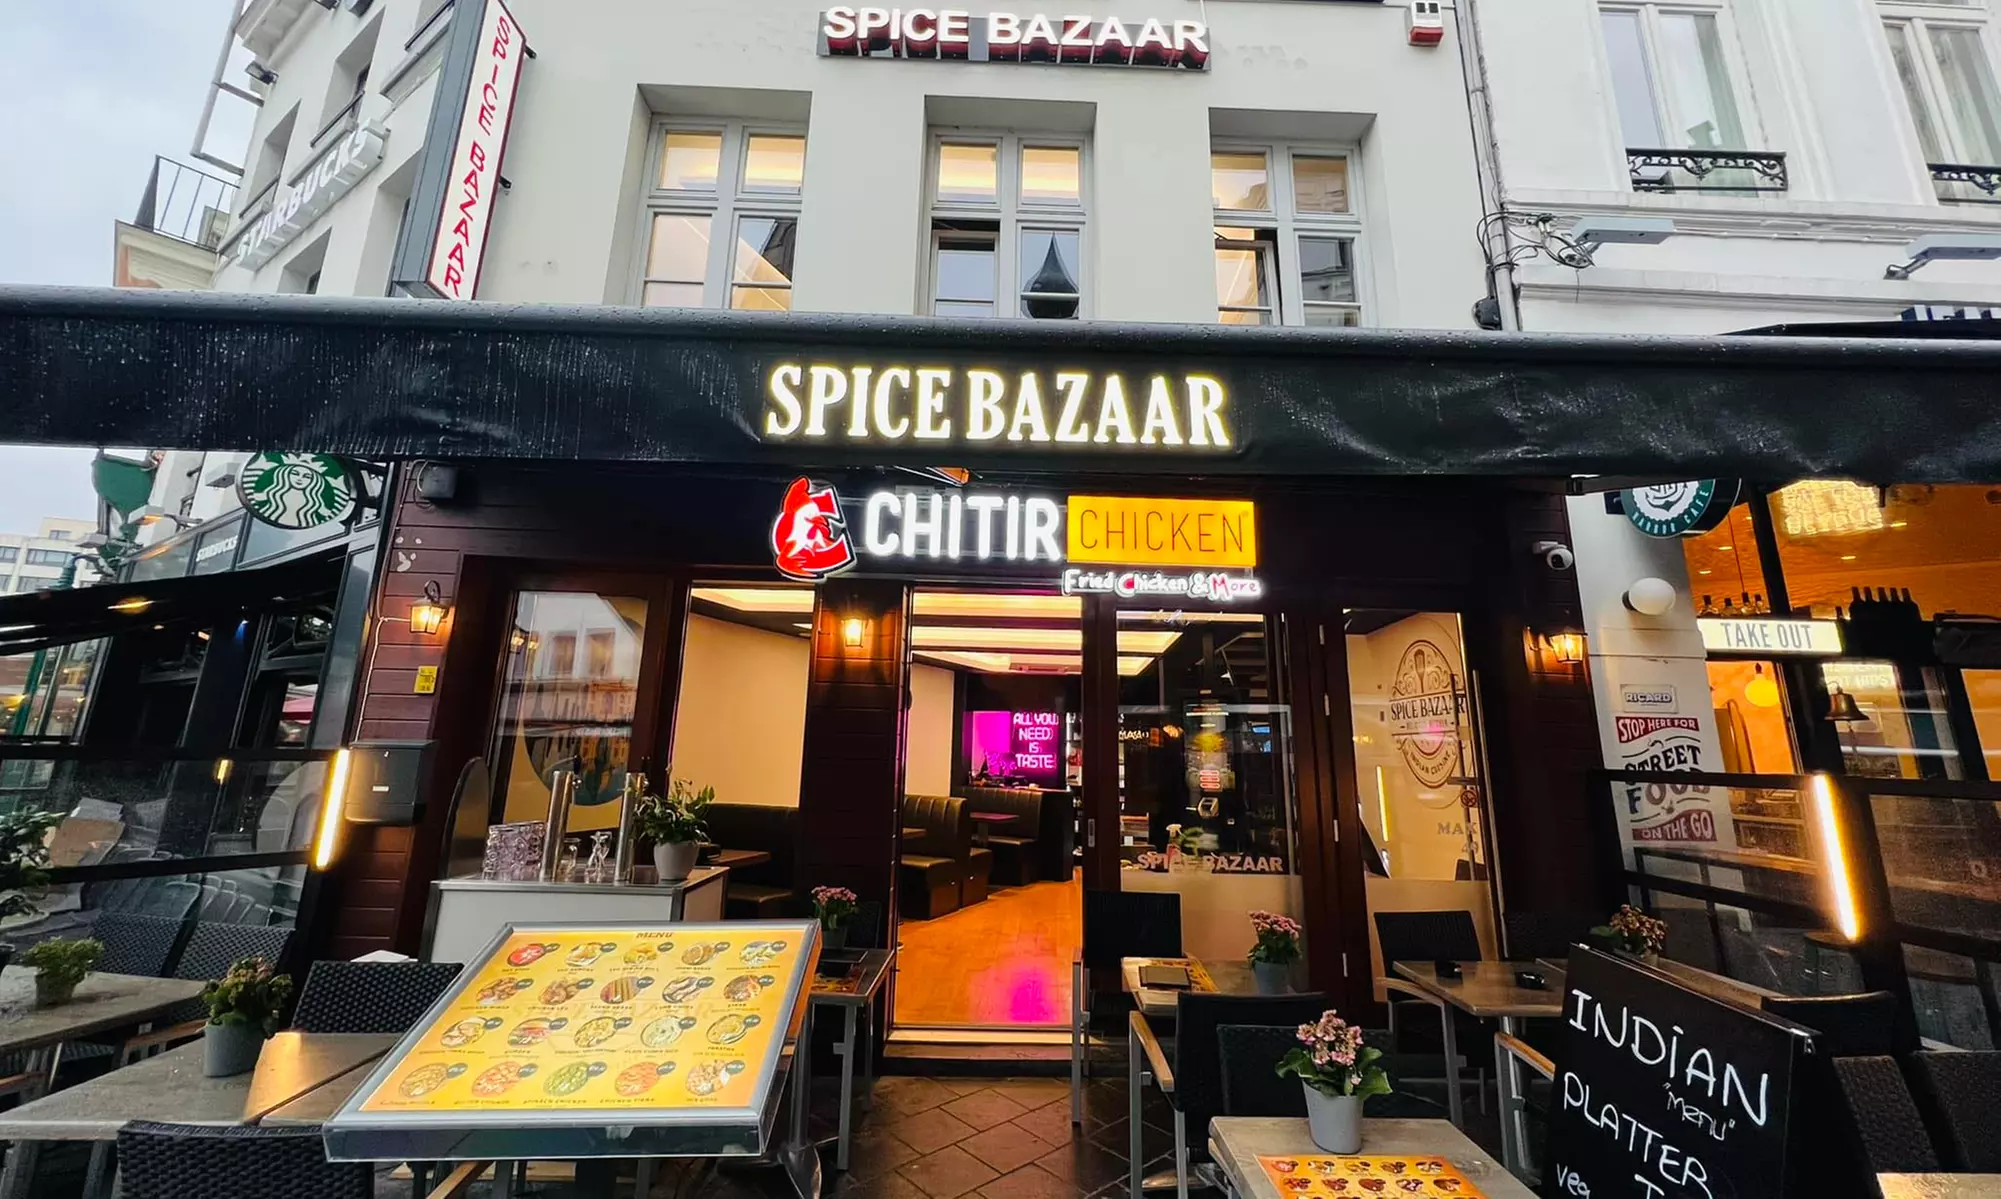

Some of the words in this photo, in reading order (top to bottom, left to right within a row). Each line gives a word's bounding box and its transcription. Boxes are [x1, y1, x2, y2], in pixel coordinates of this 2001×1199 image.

[823, 6, 970, 43] SPICE
[988, 12, 1210, 53] BAZAAR
[478, 16, 511, 136] SPICE
[236, 127, 367, 264] STARBUCKS
[444, 140, 486, 298] BAZAAR
[766, 364, 952, 439] SPICE
[966, 369, 1230, 447] BAZAAR
[864, 490, 1062, 562] CHITIR
[1080, 508, 1244, 553] CHICKEN
[1064, 569, 1114, 593] Fried
[1117, 570, 1188, 597] Chicken
[1210, 573, 1259, 599] More
[1720, 621, 1772, 648] TAKE
[1777, 623, 1812, 649] OUT
[1391, 699, 1419, 721] SPICE
[1625, 691, 1673, 703] RICARD
[1013, 712, 1033, 726] ALL
[1034, 712, 1058, 726] YOU
[1617, 718, 1646, 742] STOP
[1648, 718, 1672, 732] HERE
[1674, 718, 1697, 729] FOR
[1018, 726, 1052, 741] NEED
[1028, 741, 1040, 754] IS
[1015, 753, 1055, 769] TASTE
[1641, 827, 1662, 840] ON
[1665, 818, 1689, 840] THE
[1690, 811, 1713, 839] GO
[1202, 854, 1284, 872] BAZAAR
[635, 931, 674, 939] MENU
[1563, 1071, 1714, 1199] PLATTER
